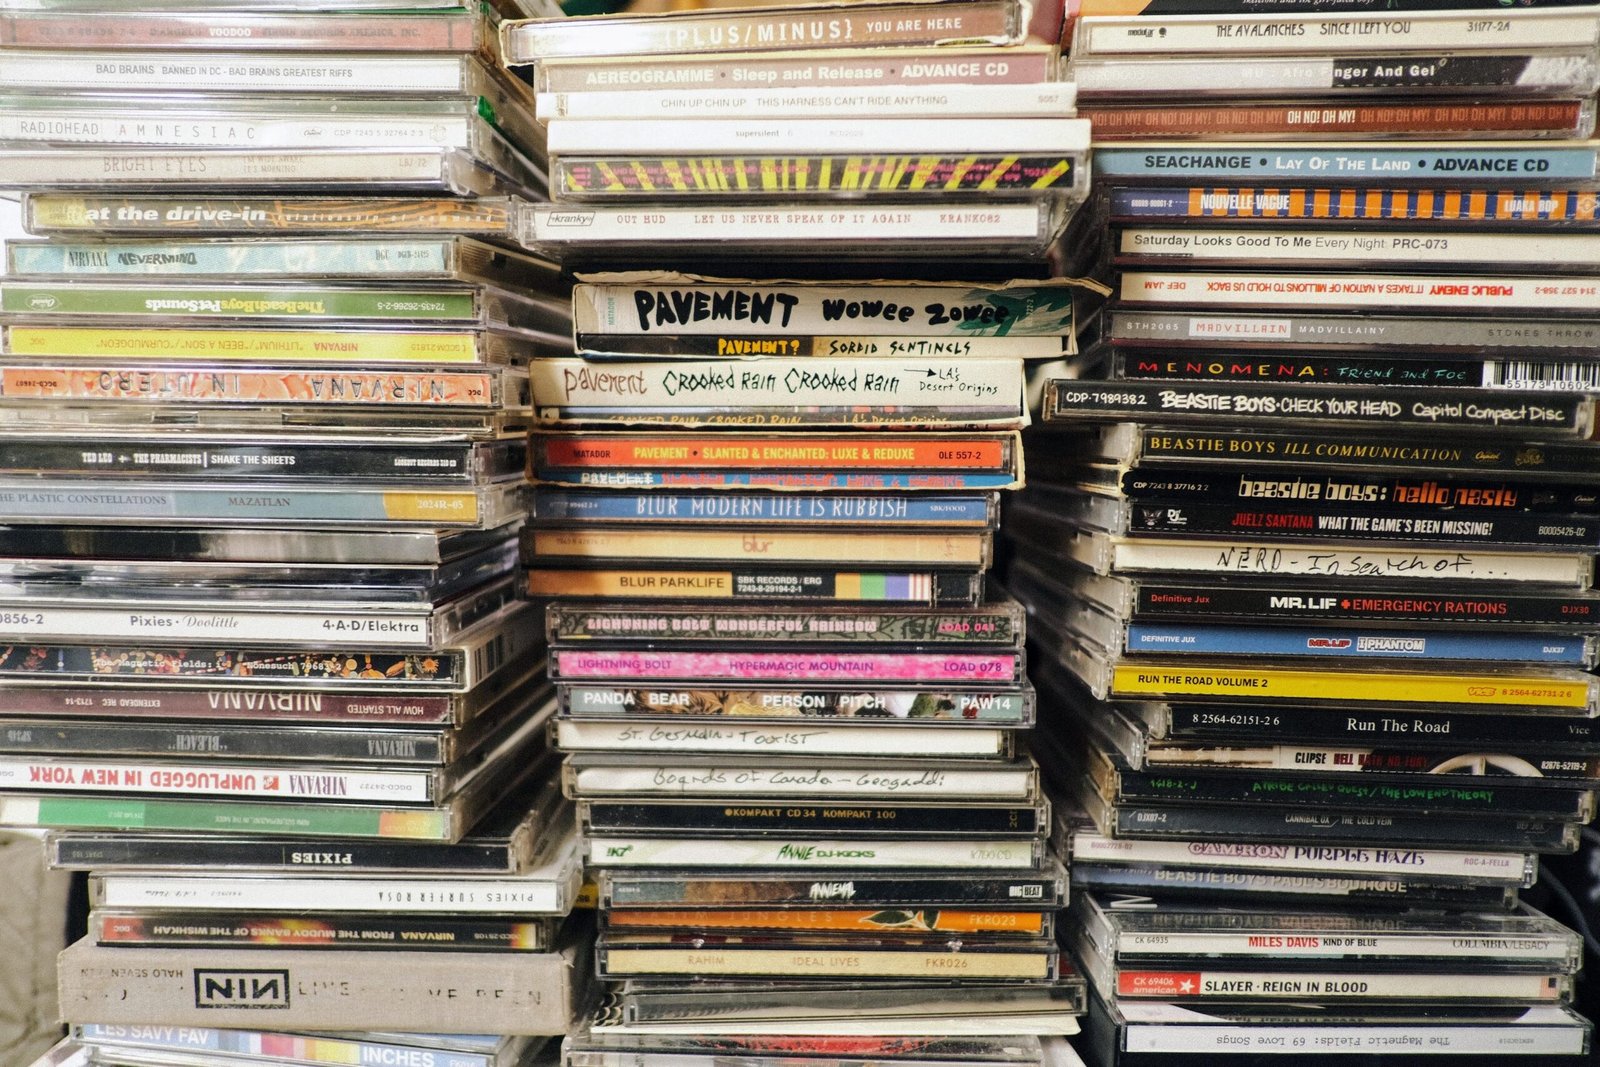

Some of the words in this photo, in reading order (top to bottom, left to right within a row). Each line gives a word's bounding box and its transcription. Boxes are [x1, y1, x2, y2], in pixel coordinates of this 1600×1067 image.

[866, 21, 891, 33] YOU
[897, 19, 922, 31] ARE
[927, 17, 962, 30] HERE
[1216, 24, 1232, 37] THE
[1236, 23, 1305, 37] AVALANCHES
[1320, 22, 1350, 35] SINCE
[1358, 22, 1380, 34] LEFT
[1384, 21, 1411, 34] YOU
[209, 27, 251, 39] VOODOO
[96, 65, 116, 75] BAD
[119, 65, 155, 75] BRAINS
[162, 66, 196, 76] BANNED
[199, 67, 207, 77] IN
[209, 67, 221, 77] DC
[229, 68, 246, 77] BAD
[249, 68, 280, 78] BRAINS
[283, 68, 327, 78] GREATEST
[329, 69, 352, 79] RIFFS
[587, 69, 714, 85] AEREOGRAMME
[733, 67, 777, 84] Sleep
[783, 67, 811, 79] and
[819, 68, 883, 79] Release
[902, 63, 979, 78] ADVANCE
[986, 62, 1008, 76] CD
[20, 121, 99, 136] RADIOHEAD
[104, 158, 156, 173] BRIGHT
[165, 158, 206, 173] EYES
[1145, 156, 1251, 169] SEACHANGE
[1433, 158, 1517, 171] ADVANCE
[1524, 158, 1549, 172] CD
[88, 207, 110, 220] at
[117, 207, 156, 221] the
[166, 207, 266, 221] drive-in
[617, 215, 637, 224] OUT
[644, 215, 666, 224] HUD
[694, 215, 715, 224] LET
[722, 215, 736, 224] US
[742, 214, 780, 224] NEVER
[786, 214, 824, 224] SPEAK
[831, 214, 845, 224] OF
[852, 214, 865, 224] IT
[872, 214, 911, 224] AGAIN
[1134, 234, 1190, 247] Saturday
[1194, 235, 1232, 246] Looks
[1236, 236, 1270, 247] Good
[1274, 236, 1289, 247] To
[1293, 237, 1311, 247] Me
[1316, 237, 1349, 250] Every
[1353, 238, 1385, 250] Night
[1392, 239, 1448, 250] PRC-073
[117, 252, 197, 265] NEVERMIND
[1429, 285, 1469, 295] ENEMY
[1472, 285, 1513, 296] PUBLIC
[634, 290, 799, 331] PAVEMENT
[1196, 323, 1287, 333] MADVILLAIN
[718, 338, 800, 355] PAVEMENT?
[829, 341, 878, 355] SORDID
[1159, 391, 1231, 410] BEASTIE
[1326, 398, 1358, 415] YOUR
[1360, 400, 1402, 417] HEAD
[1412, 402, 1462, 422] Capitol
[1466, 404, 1527, 425] Compact
[1530, 407, 1566, 421] Disc
[634, 447, 688, 459] PAVEMENT
[702, 448, 749, 459] SLANTED
[763, 448, 827, 460] ENCHANTED:
[832, 448, 858, 459] LUXE
[874, 449, 915, 460] REDUXE
[939, 451, 953, 459] OLE
[956, 451, 981, 459] 557-2
[1151, 437, 1224, 451] BEASTIE
[1230, 440, 1276, 453] BOYS
[1283, 442, 1311, 455] ILL
[1316, 444, 1462, 461] COMMUNICATION
[211, 454, 240, 465] SHAKE
[243, 455, 260, 465] THE
[262, 455, 296, 465] SHEETS
[17, 493, 62, 503] PLASTIC
[68, 494, 166, 505] CONSTELLATIONS
[228, 497, 291, 507] MAZATLAN
[637, 496, 678, 515] BLUR
[692, 497, 763, 516] MODERN
[771, 497, 802, 516] LIFE
[810, 498, 825, 517] IS
[833, 498, 907, 518] RUBBISH
[1232, 512, 1263, 527] JUELZ
[1265, 514, 1313, 529] SANTANA
[1318, 516, 1348, 530] WHAT
[1351, 517, 1370, 531] THE
[1372, 518, 1412, 532] GAME'S
[1414, 520, 1440, 534] BEEN
[1442, 520, 1493, 536] MISSING!
[620, 576, 656, 587] BLUR
[659, 577, 725, 589] PARKLIFE
[1353, 599, 1442, 612] EMERGENCY
[1445, 601, 1507, 615] RATIONS
[130, 615, 172, 627] Pixies
[183, 615, 240, 629] Doolittle
[578, 659, 643, 670] LIGHTNING
[645, 660, 672, 670] BOLT
[729, 661, 805, 672] HYPERMAGIC
[809, 661, 874, 672] MOUNTAIN
[944, 662, 976, 672] LOAD
[980, 662, 1002, 672] 078
[1138, 675, 1160, 684] RUN
[1163, 675, 1182, 684] THE
[1185, 676, 1213, 686] ROAD
[1216, 677, 1259, 687] VOLUME
[583, 692, 635, 705] PANDA
[649, 693, 690, 706] BEAR
[762, 695, 825, 708] PERSON
[839, 696, 886, 709] PITCH
[960, 697, 1012, 710] PAW14
[347, 704, 385, 715] STARTED
[386, 704, 402, 715] ALL
[403, 705, 424, 715] HOW
[1202, 714, 1270, 726] 2564-62151-2
[1347, 718, 1376, 731] Run
[1381, 719, 1408, 732] The
[1413, 720, 1450, 733] Road
[1569, 725, 1590, 734] Vice
[30, 766, 75, 784] YORK
[82, 768, 119, 785] NEW
[124, 770, 142, 786] IN
[150, 771, 256, 790] UNPLUGGED
[289, 775, 347, 796] NIRVANA
[292, 851, 352, 864] PIXIES
[379, 892, 412, 902] ROSA
[421, 892, 474, 902] SURFER
[486, 893, 534, 902] PIXIES
[1248, 936, 1283, 947] MILES
[1286, 937, 1319, 947] DAVIS
[1323, 938, 1342, 947] KIND
[1345, 938, 1355, 947] OF
[1357, 938, 1377, 947] BLUE
[688, 955, 725, 965] RAHIM
[793, 956, 824, 966] IDEAL
[830, 957, 860, 967] LIVES
[1205, 980, 1253, 993] SLAYER
[1263, 981, 1301, 993] REIGN
[1306, 982, 1319, 992] IN
[1325, 982, 1368, 993] BLOOD
[130, 1026, 174, 1042] SAVY
[178, 1030, 211, 1044] FAV
[1216, 1035, 1250, 1046] Songs
[1257, 1036, 1286, 1046] Love
[1429, 1037, 1450, 1045] The
[362, 1047, 434, 1067] INCHES
